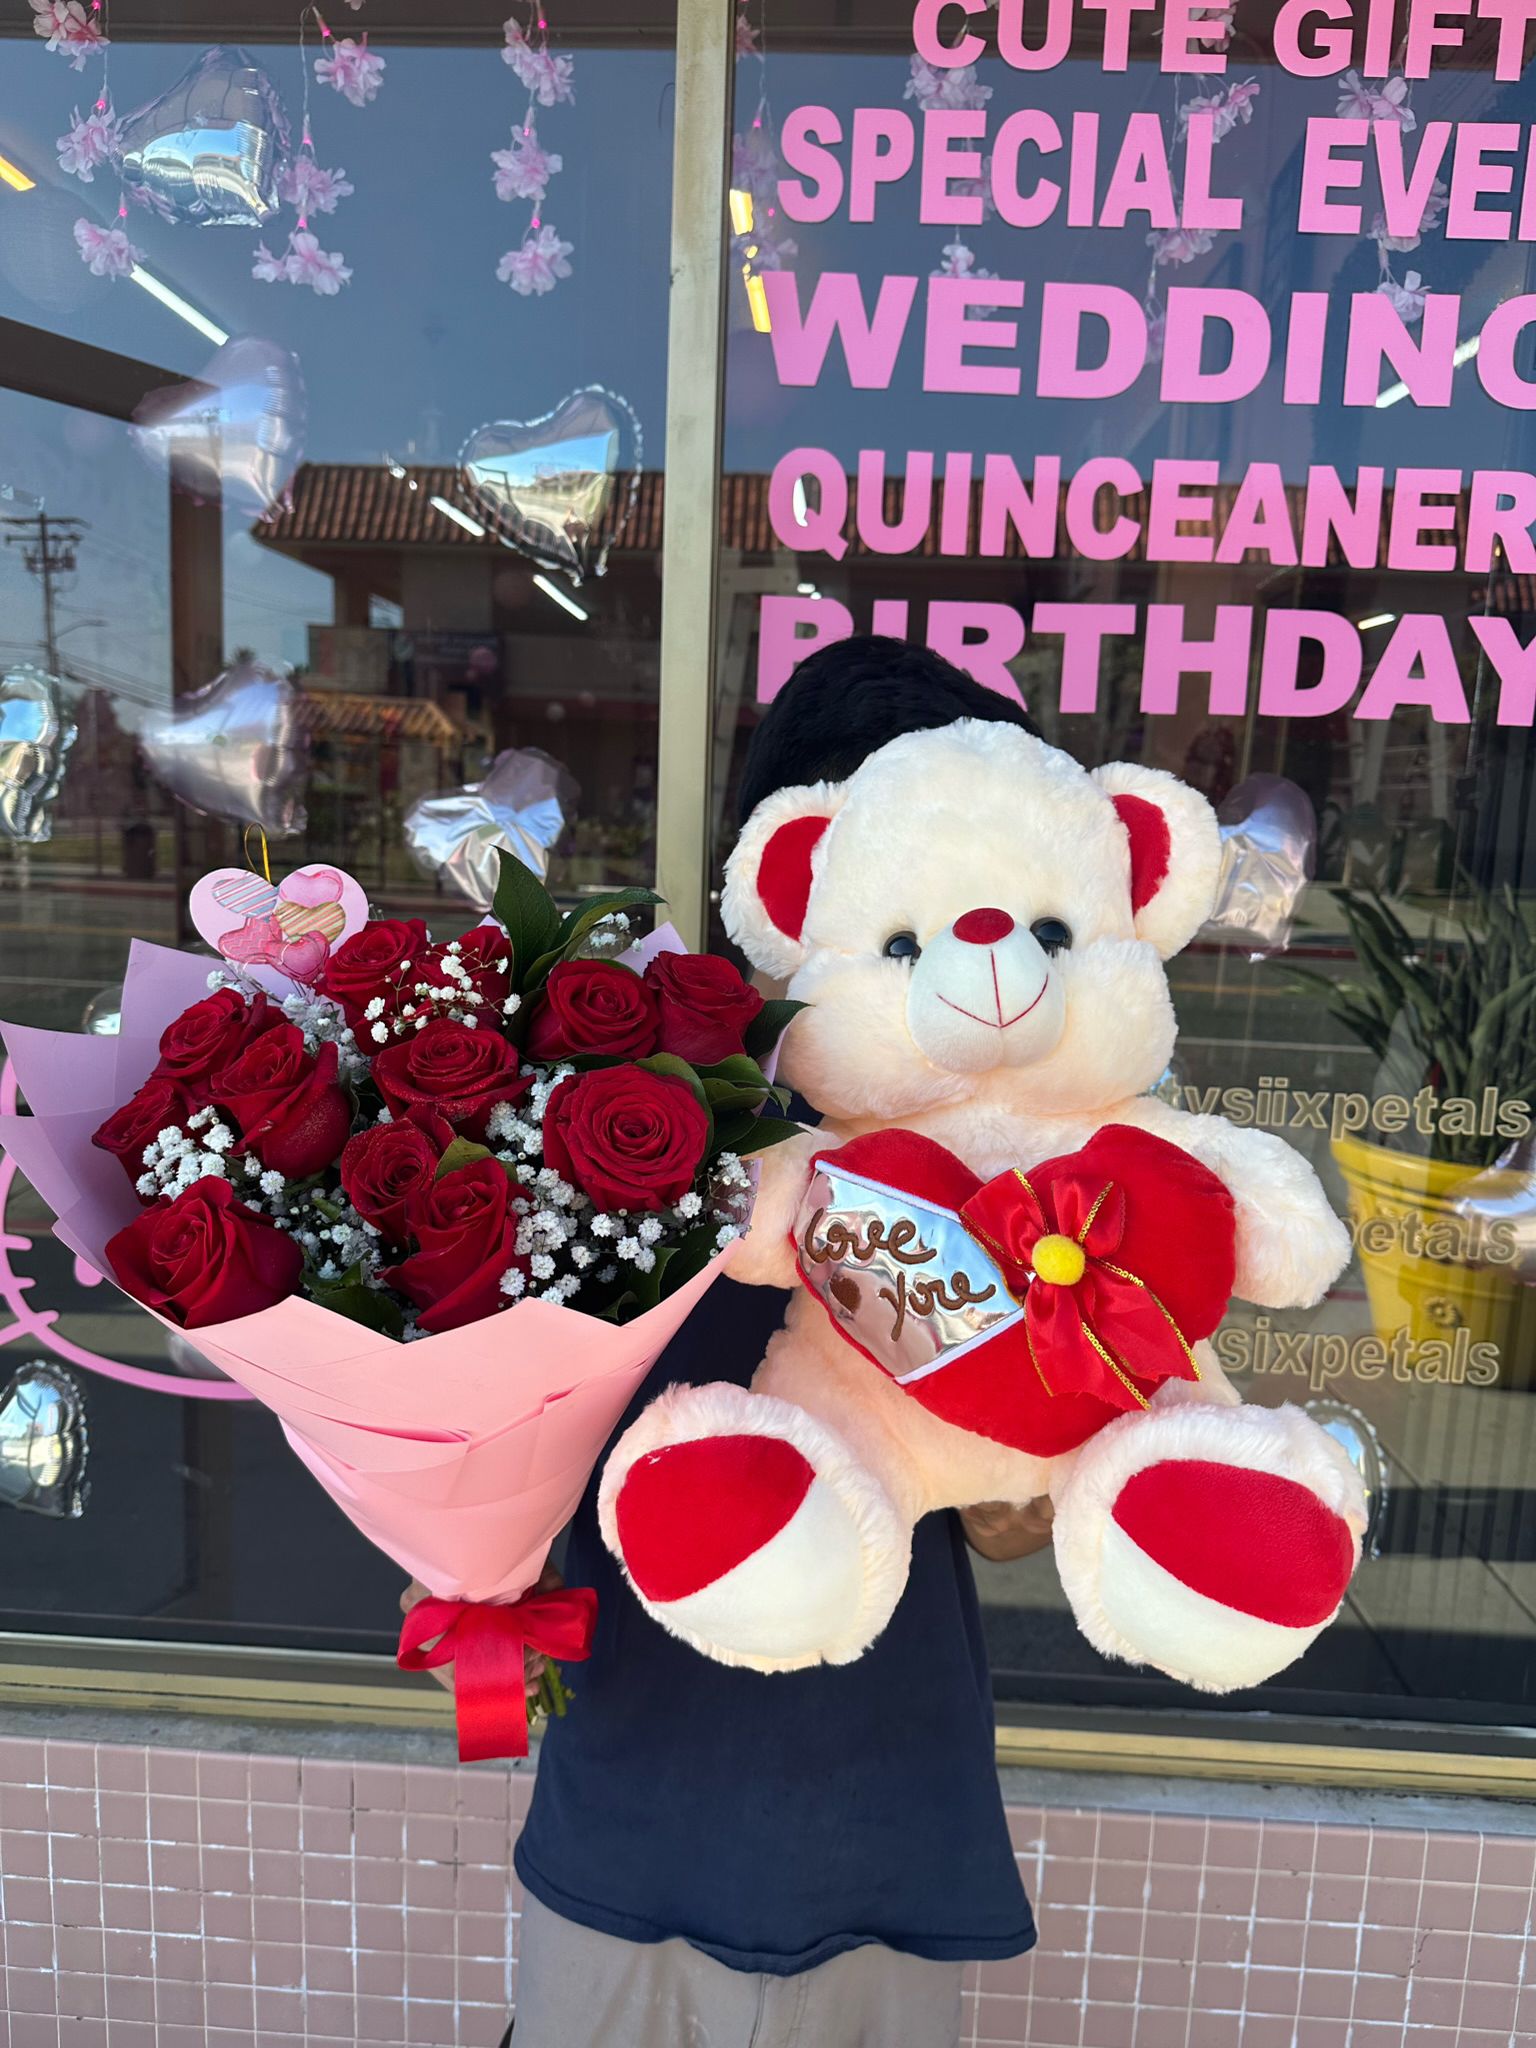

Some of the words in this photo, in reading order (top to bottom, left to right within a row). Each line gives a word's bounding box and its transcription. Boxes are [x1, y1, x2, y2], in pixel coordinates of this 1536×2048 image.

[913, 0, 1231, 73] CUTE
[778, 105, 1244, 230] SPECIAL
[1298, 116, 1536, 241] EVE
[768, 447, 1536, 574] QUINCEANER
[1340, 1209, 1519, 1265] etals
[1211, 1315, 1501, 1392] sixpetals
